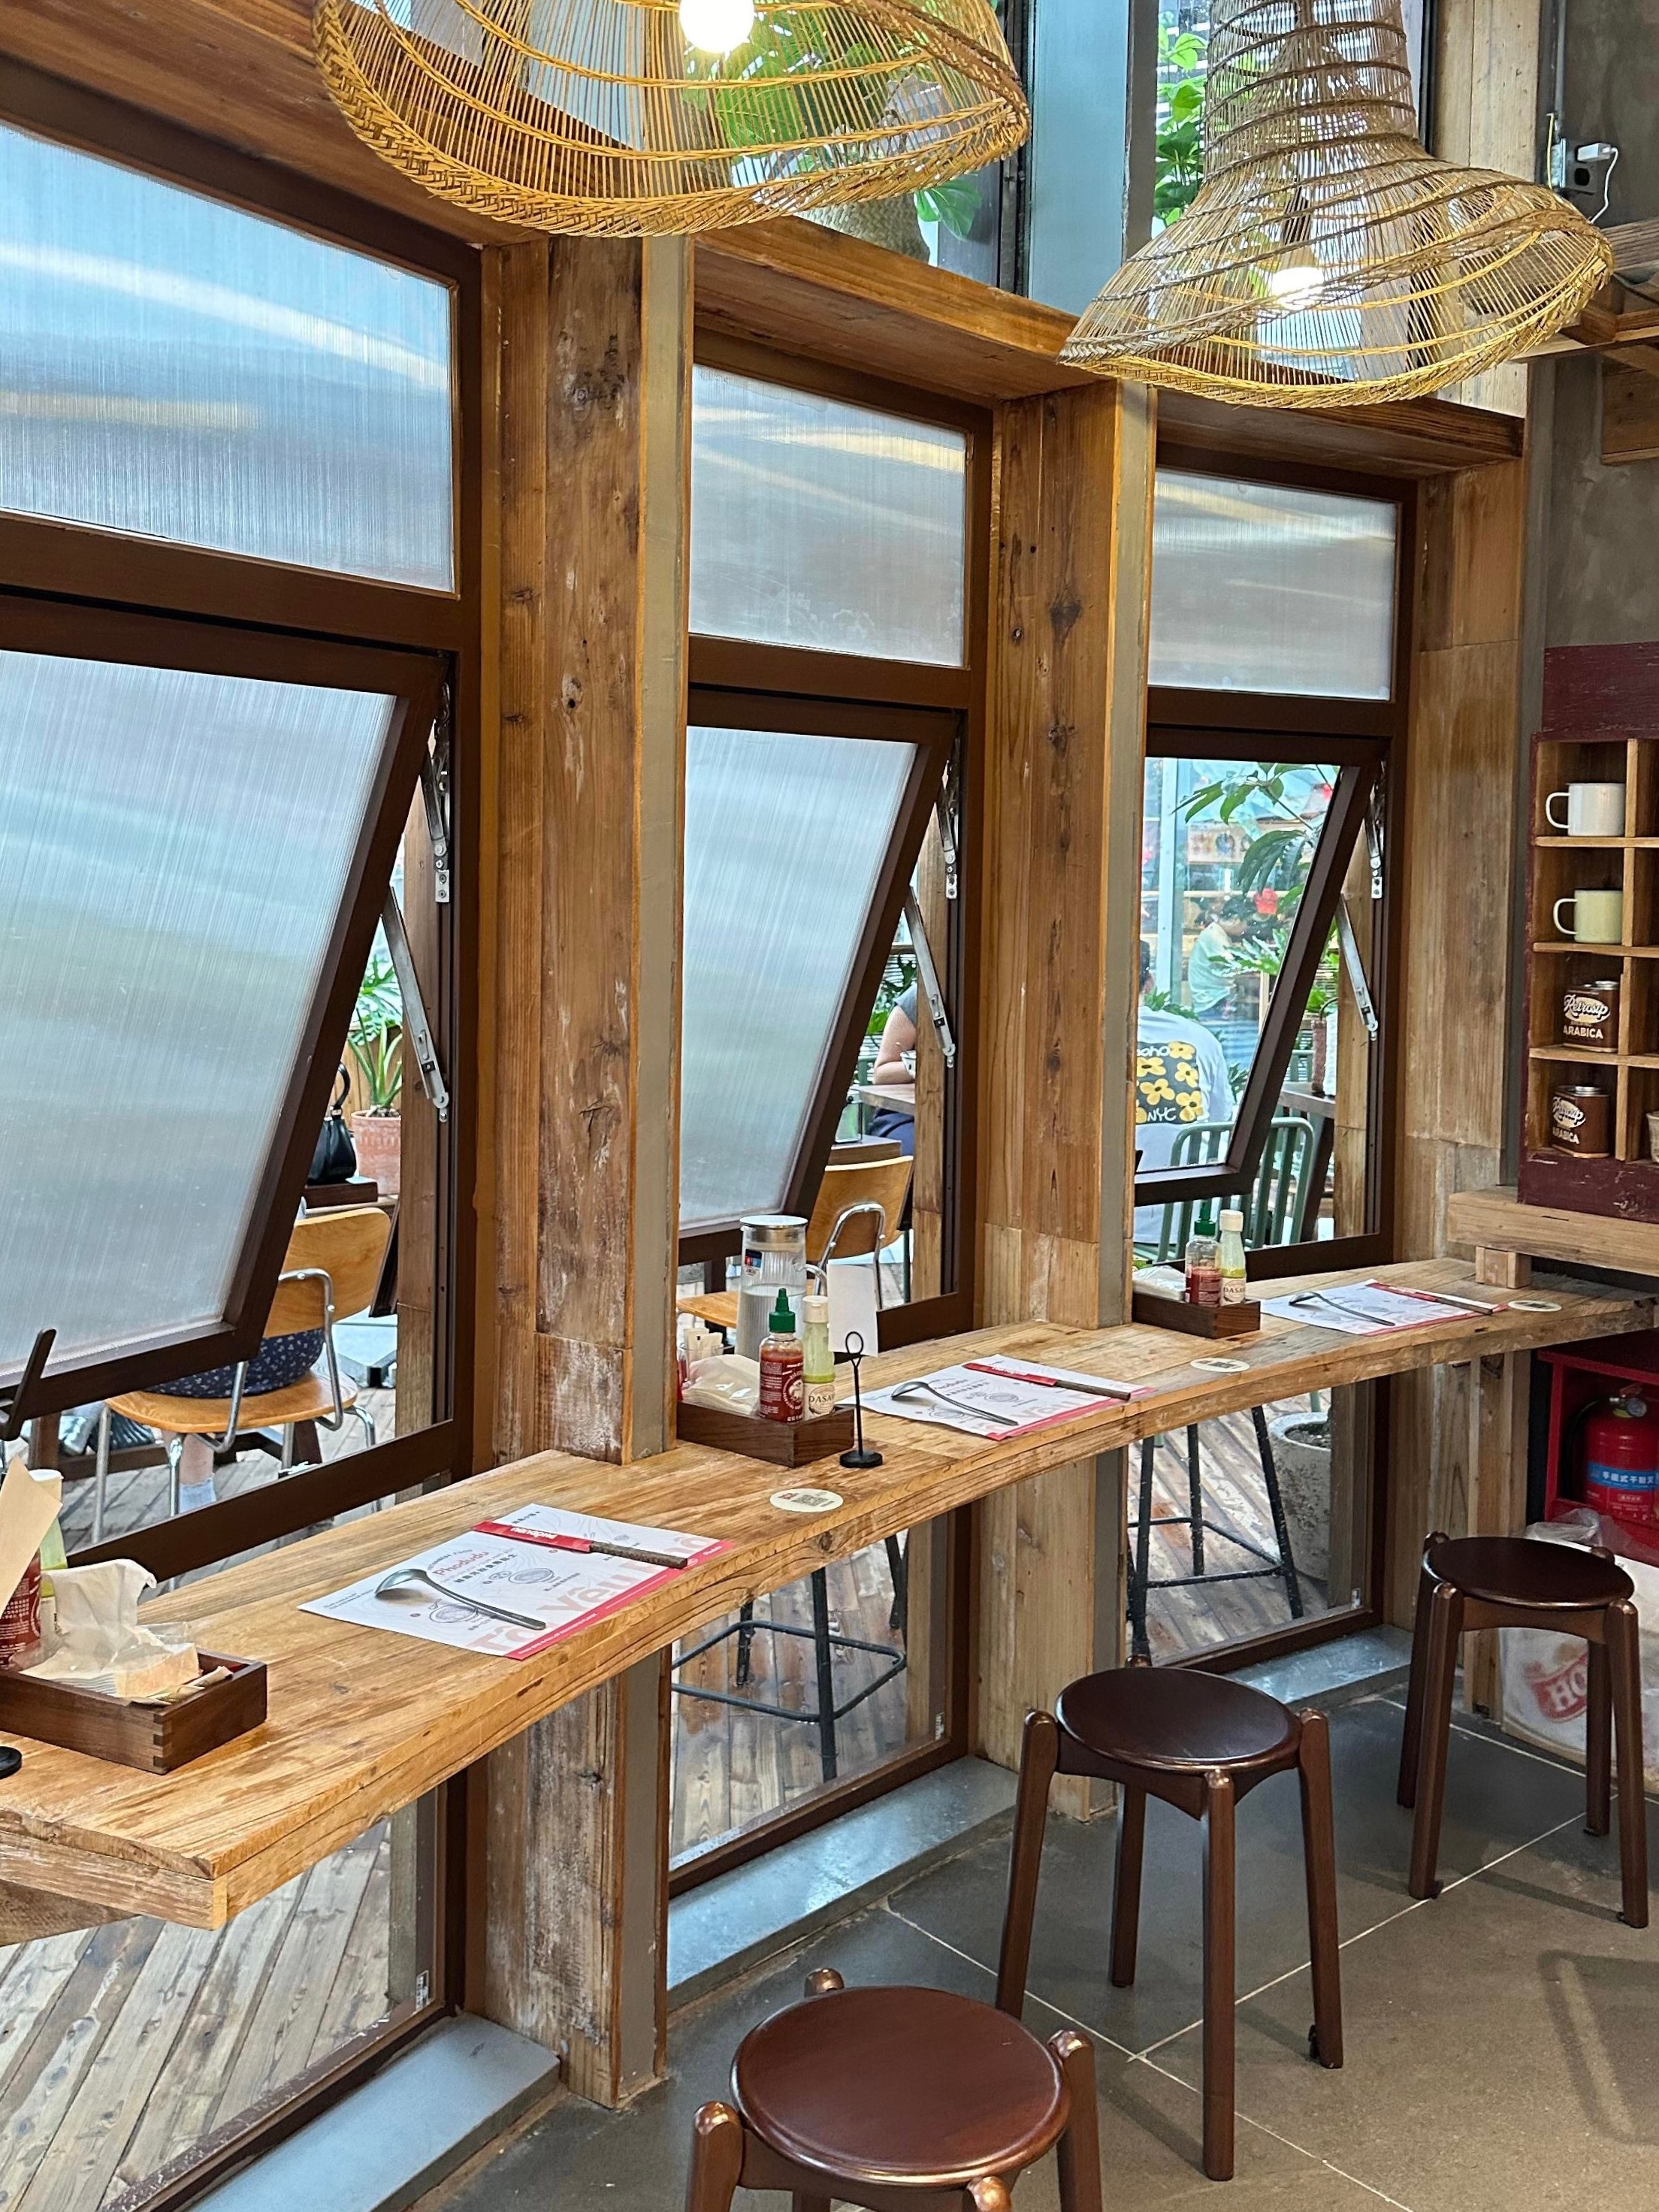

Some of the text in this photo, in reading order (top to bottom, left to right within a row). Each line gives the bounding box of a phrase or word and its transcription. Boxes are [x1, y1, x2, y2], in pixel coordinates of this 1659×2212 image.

[1564, 1025, 1603, 1038] ARABICA
[1137, 1046, 1170, 1056] oho
[1147, 1107, 1177, 1121] NYC
[432, 1551, 489, 1576] Phodudu
